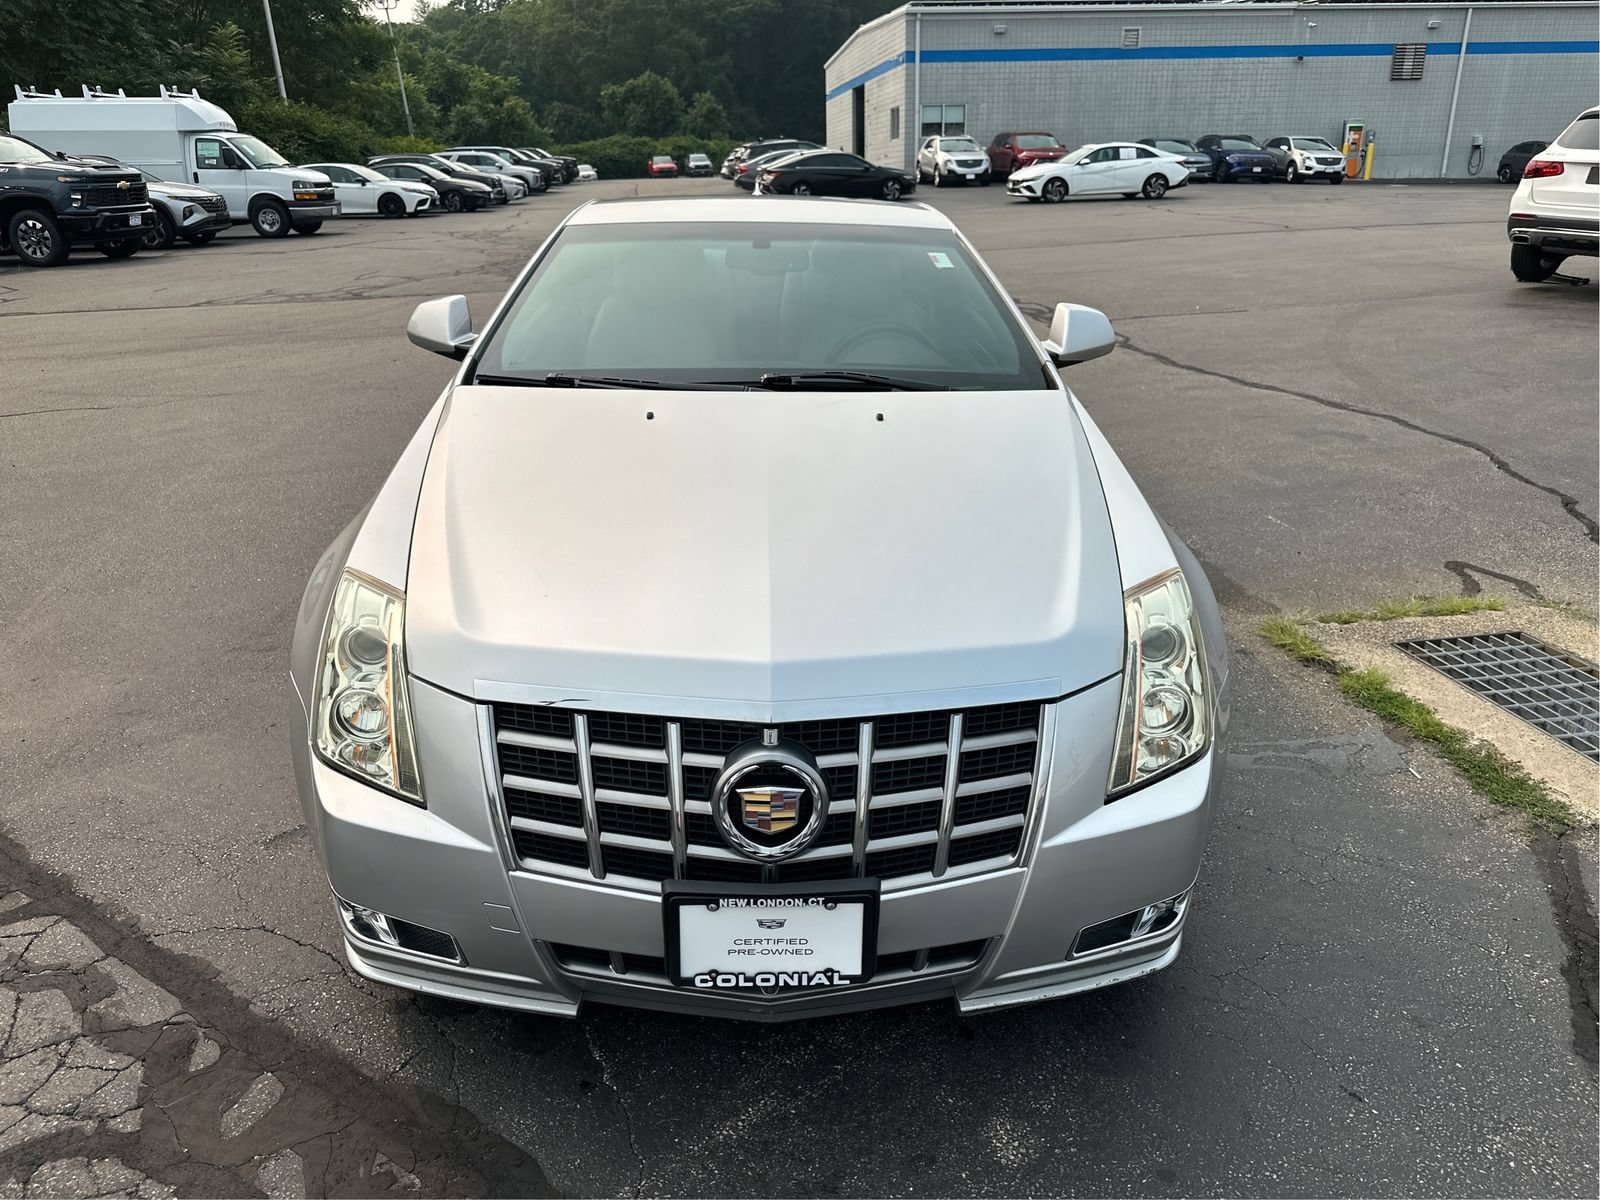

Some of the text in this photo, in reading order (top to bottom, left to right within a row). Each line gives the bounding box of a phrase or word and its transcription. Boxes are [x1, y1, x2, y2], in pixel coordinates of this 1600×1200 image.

[720, 899, 747, 908] NEW
[808, 897, 825, 907] CT
[694, 972, 850, 987] COLONIAL
